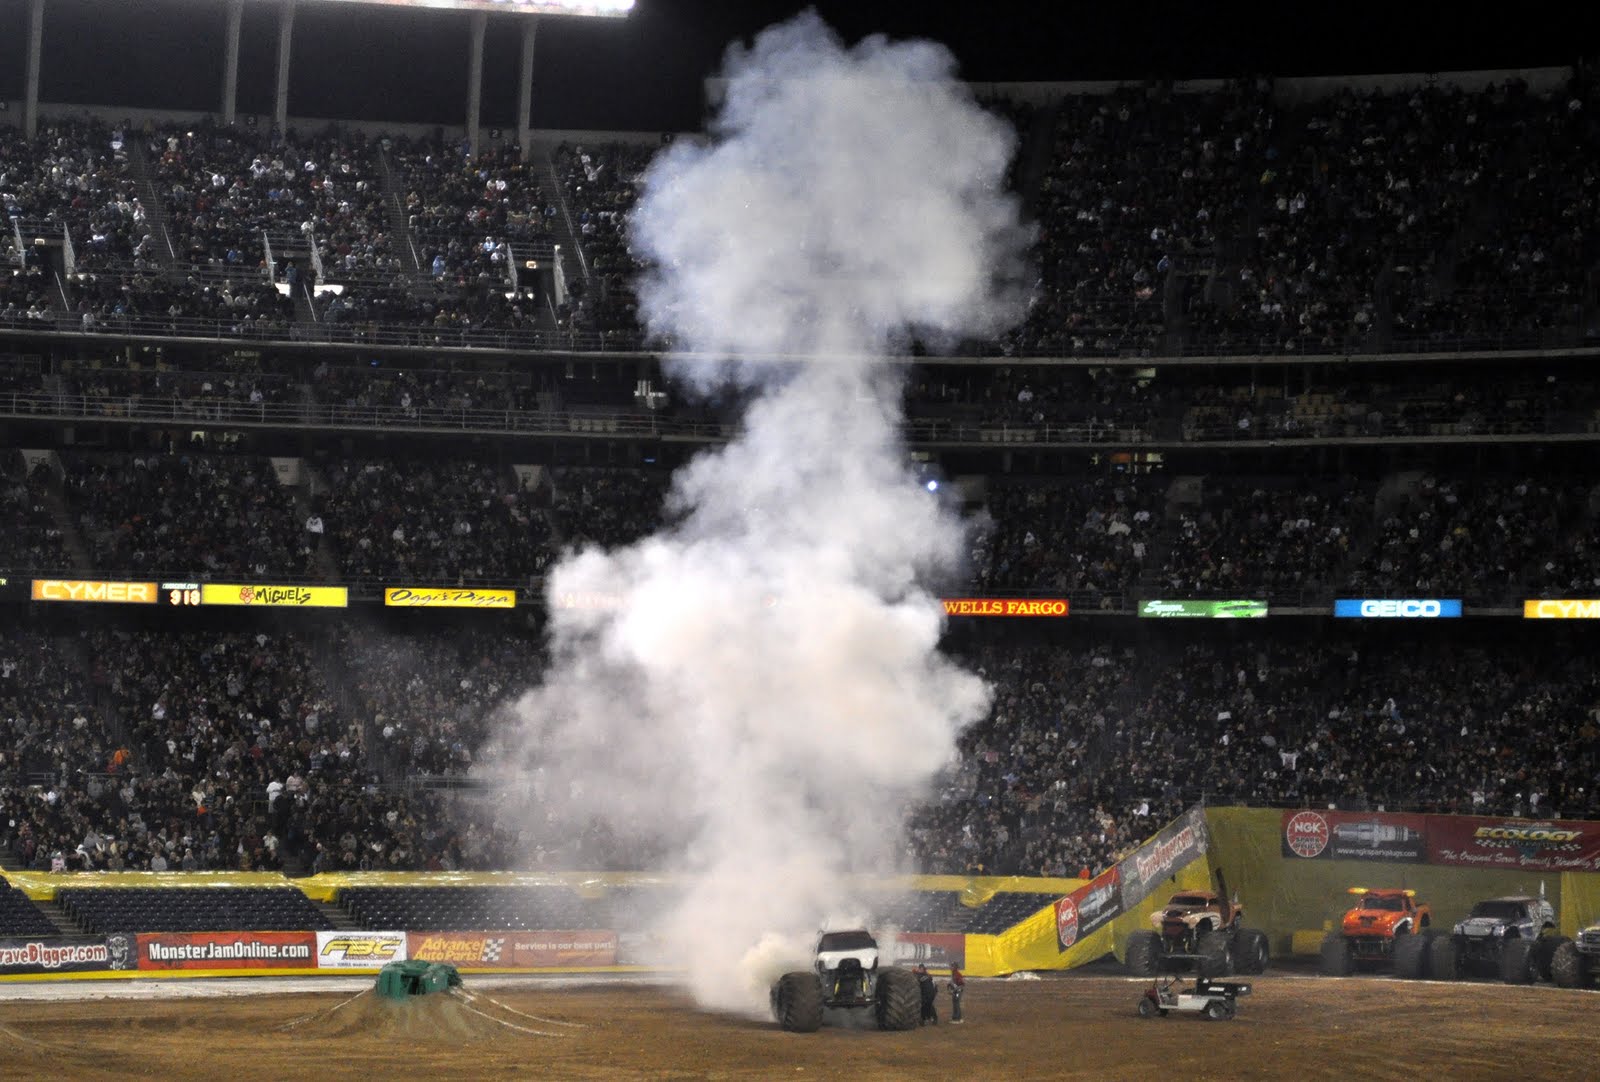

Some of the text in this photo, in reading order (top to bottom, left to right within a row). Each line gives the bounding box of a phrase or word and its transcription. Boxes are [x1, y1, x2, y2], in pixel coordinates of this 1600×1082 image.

[41, 580, 147, 600] CYMER
[390, 590, 508, 606] Oggi's Pizza
[943, 601, 1065, 615] WELLS FARGO
[1361, 600, 1441, 617] GEICO
[1294, 822, 1321, 833] NGK
[1474, 827, 1583, 841] ECOLOGY
[149, 942, 309, 960] MonsterJamOnline.com
[422, 938, 480, 951] Advance
[515, 942, 547, 950] Service
[558, 942, 572, 950] our
[413, 950, 478, 960] Auto Parts
